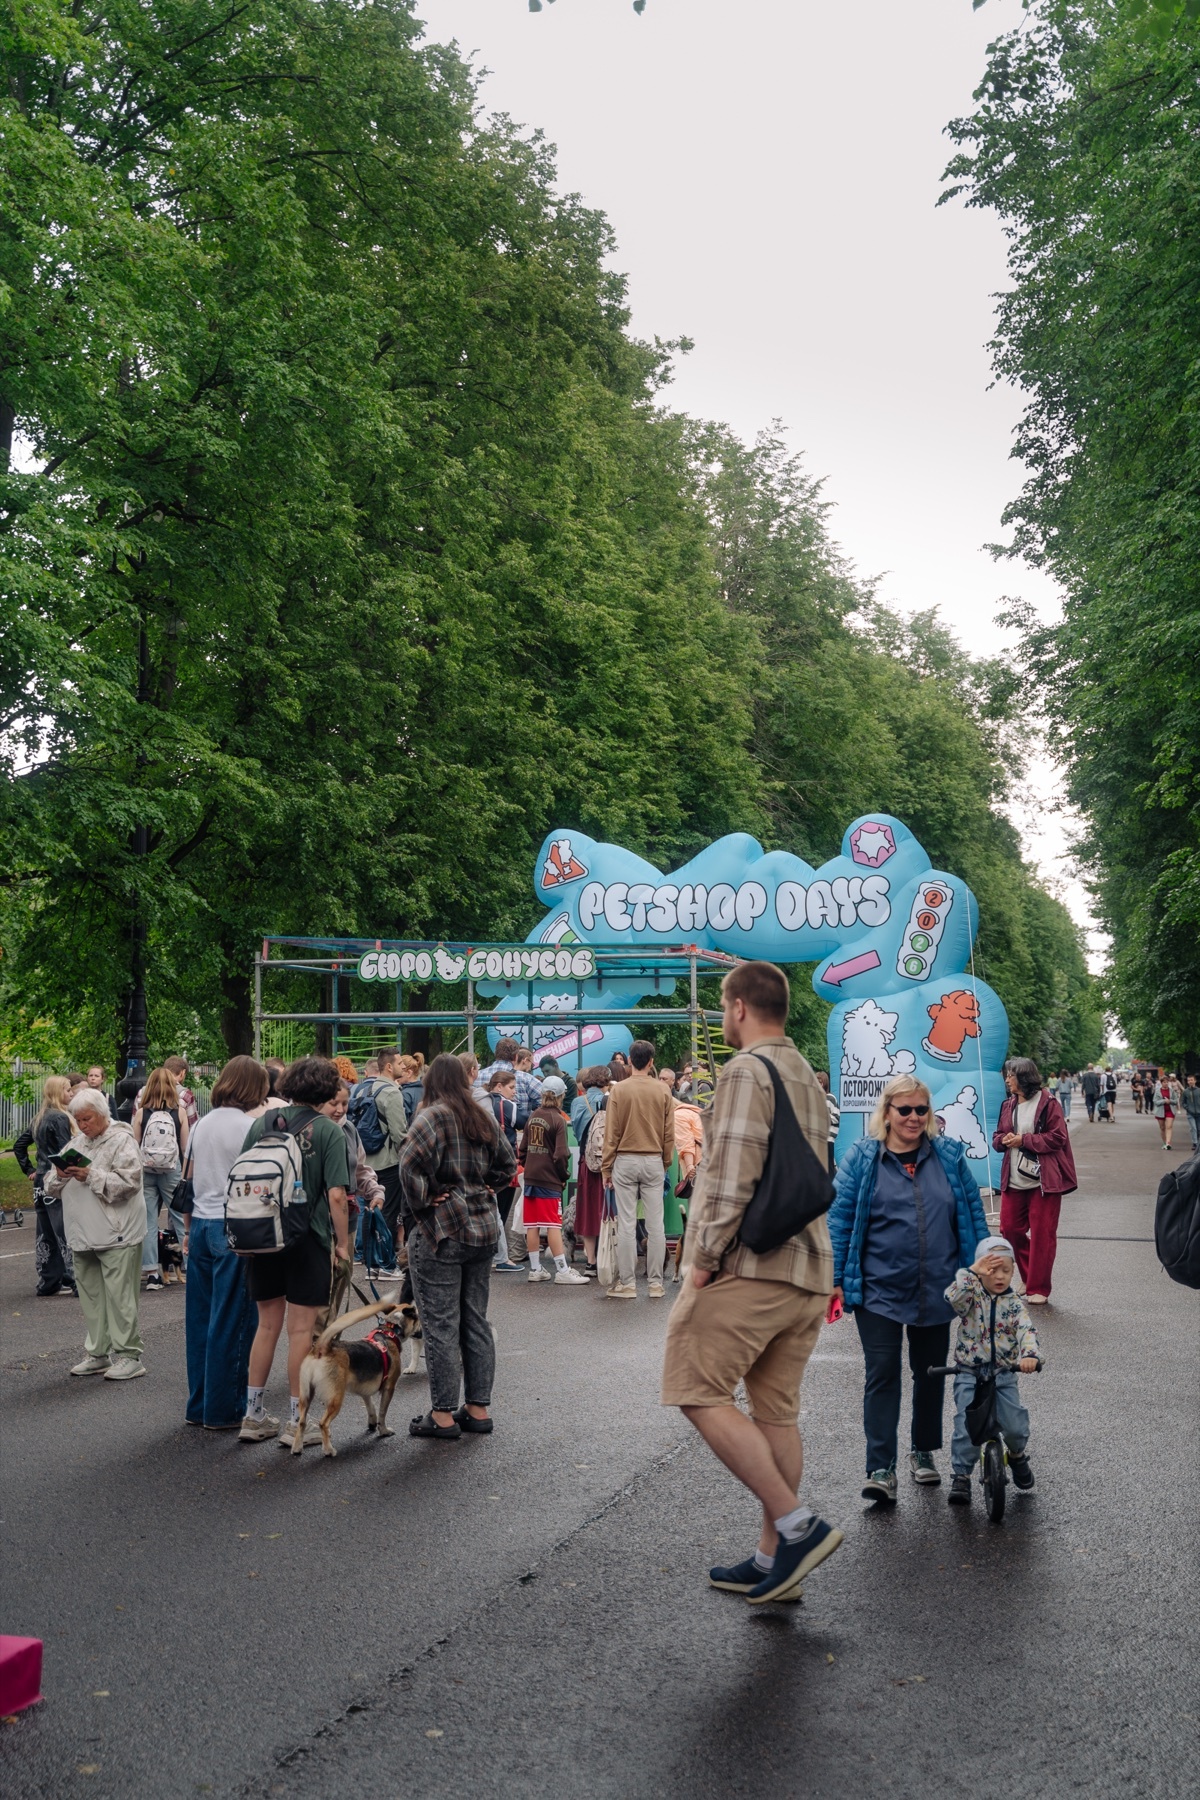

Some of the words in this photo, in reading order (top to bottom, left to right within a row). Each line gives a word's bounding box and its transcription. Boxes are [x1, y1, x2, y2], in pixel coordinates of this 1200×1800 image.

[578, 881, 767, 932] PETSHOP
[775, 874, 892, 932] DAYS
[360, 952, 433, 980] БЮРО
[468, 949, 593, 978] БОНУСОВ
[843, 1098, 867, 1106] ХОРОШИЙ
